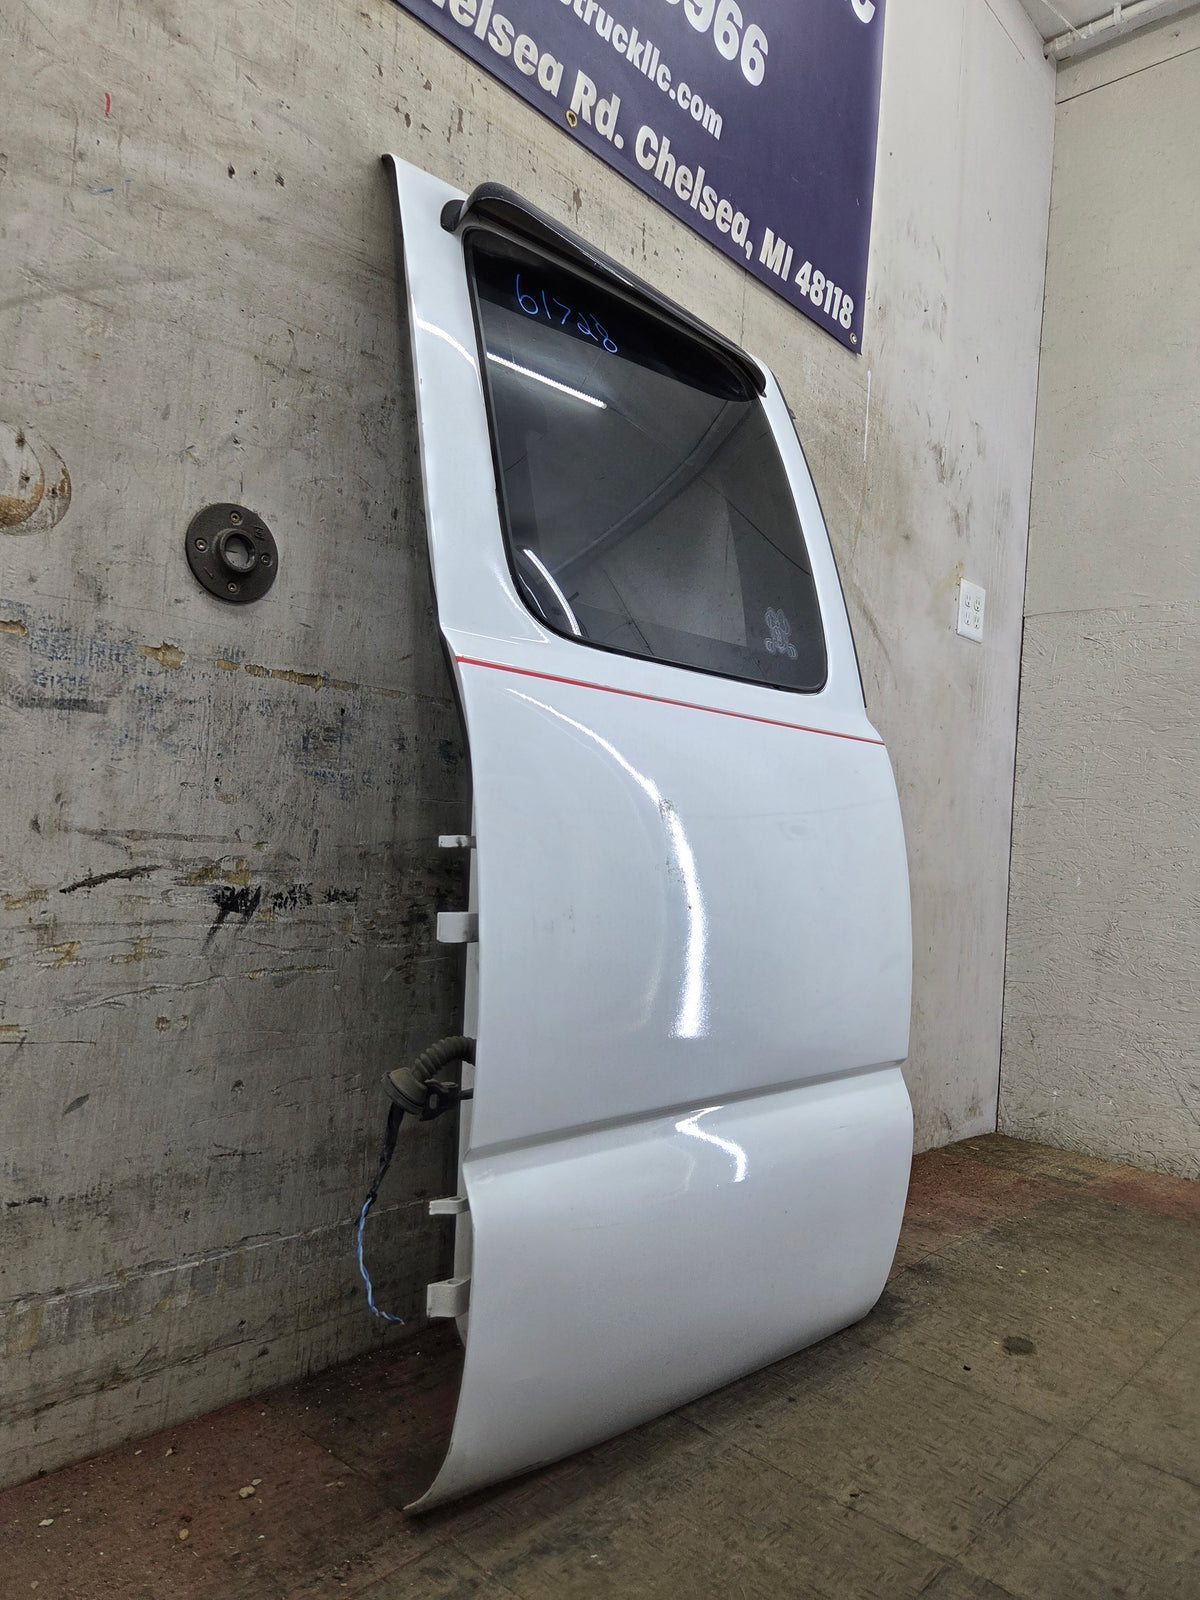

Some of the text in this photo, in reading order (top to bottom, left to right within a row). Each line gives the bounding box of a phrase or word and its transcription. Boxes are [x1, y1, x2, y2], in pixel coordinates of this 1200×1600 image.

[560, 0, 723, 140] truckllc.com
[665, 0, 768, 86] 966
[431, 0, 854, 330] elsea Rd. Chelsea, MI 48118
[516, 273, 618, 353] 61728
